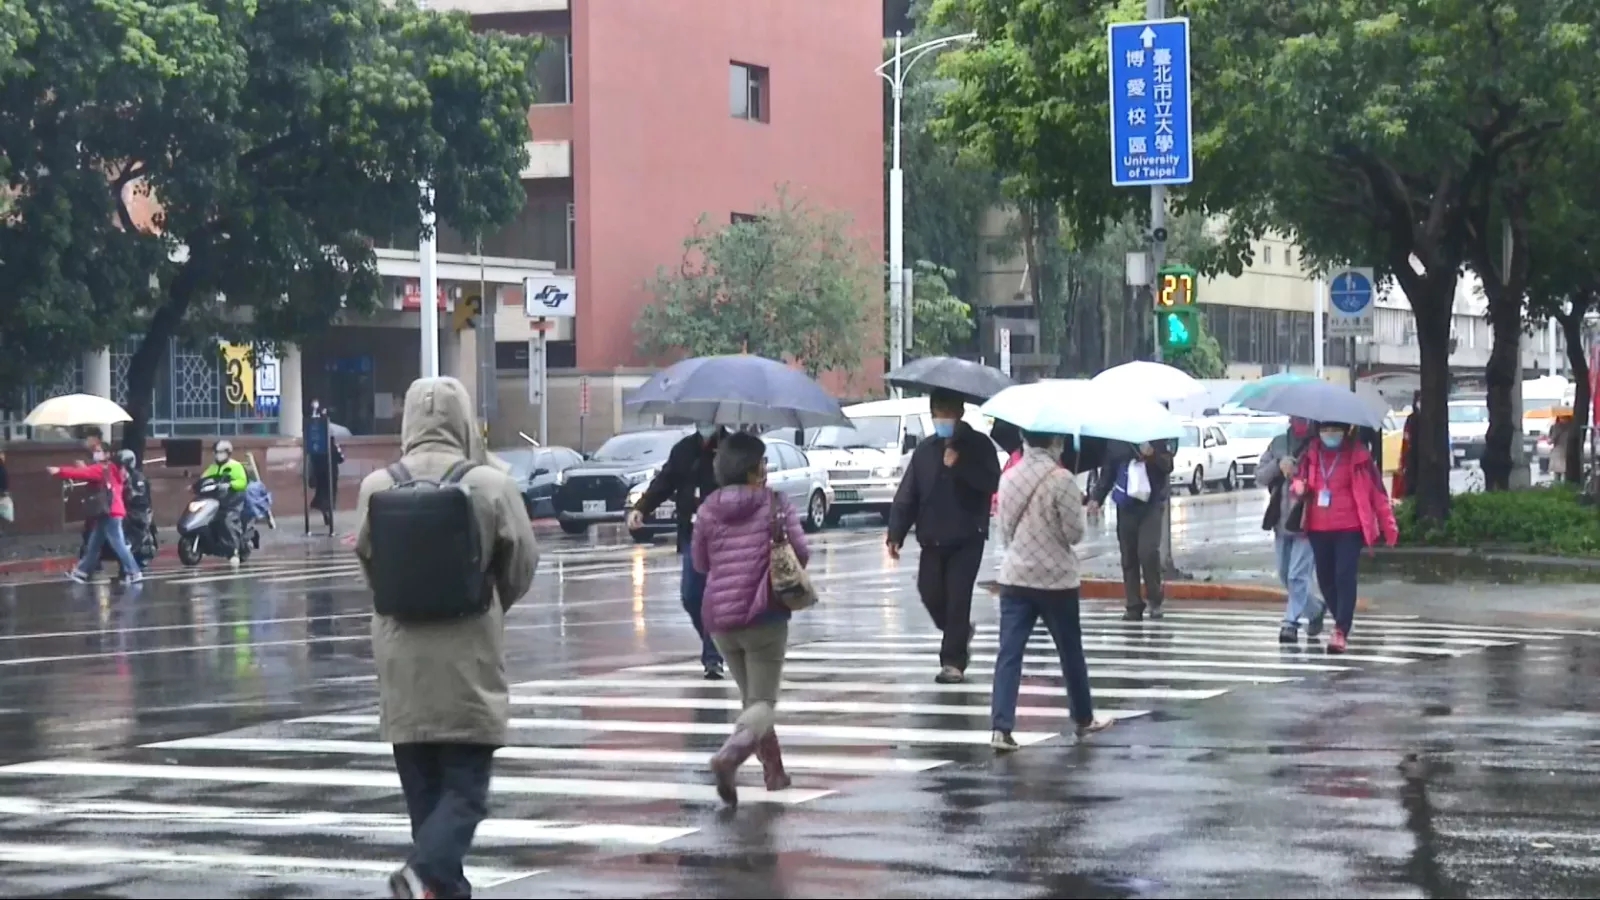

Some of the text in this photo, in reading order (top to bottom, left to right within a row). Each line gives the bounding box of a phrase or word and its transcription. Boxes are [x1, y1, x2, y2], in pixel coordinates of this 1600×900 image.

[1126, 49, 1147, 154] 博愛校區
[1152, 48, 1174, 153] 臺北市立大學
[1123, 154, 1180, 167] University
[1128, 166, 1176, 178] of Taipei
[1162, 274, 1192, 306] 27
[226, 358, 244, 405] 3
